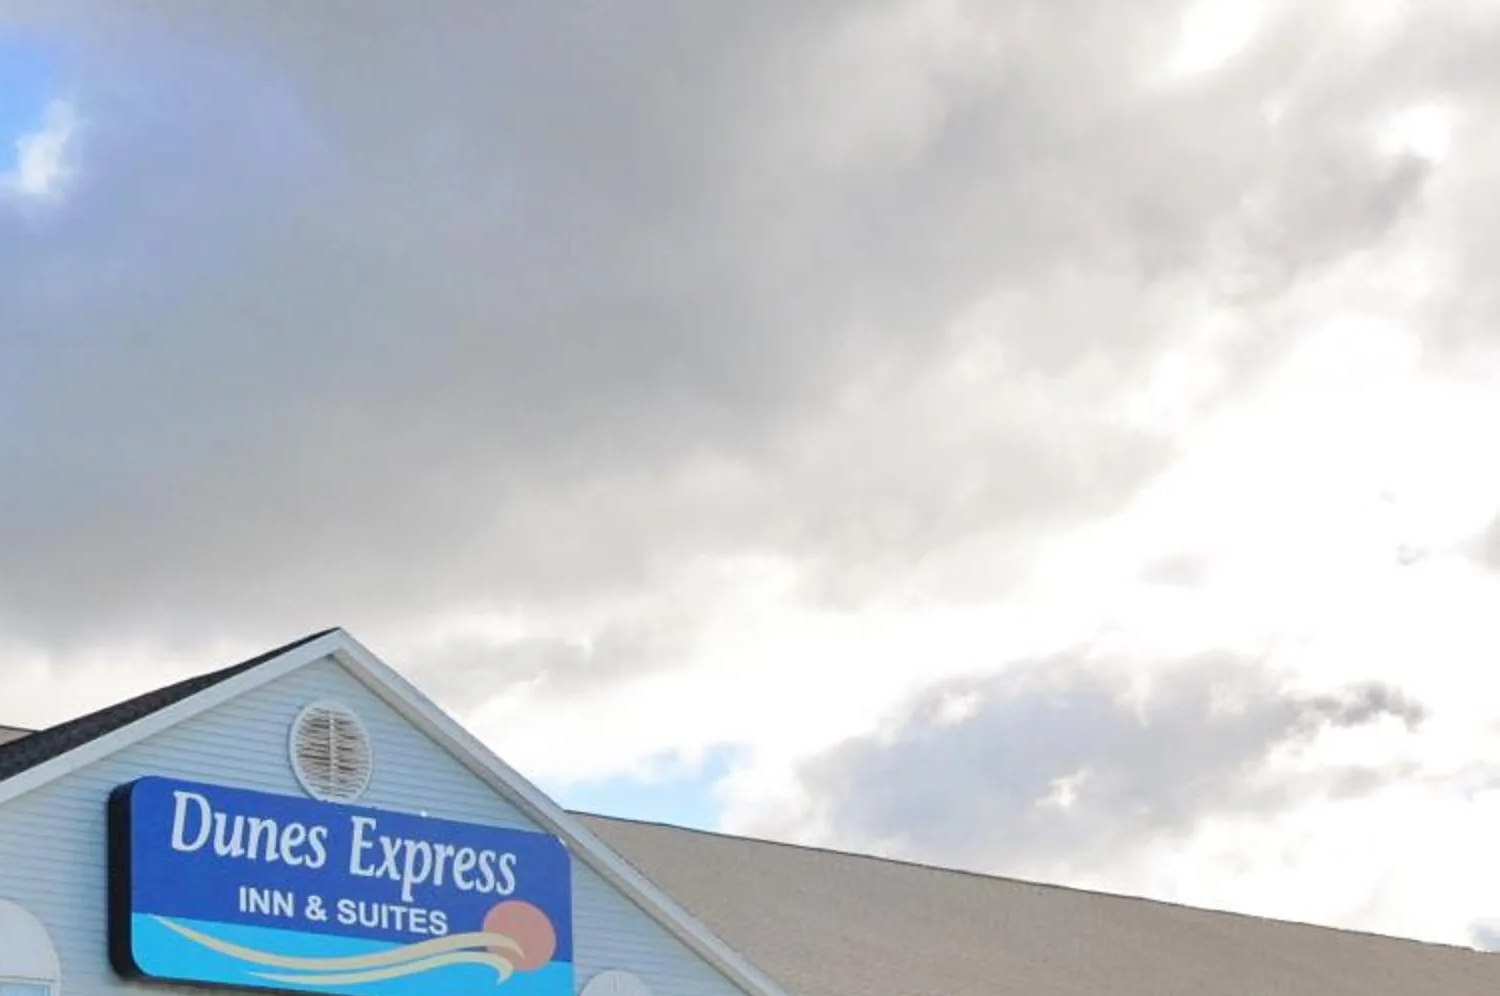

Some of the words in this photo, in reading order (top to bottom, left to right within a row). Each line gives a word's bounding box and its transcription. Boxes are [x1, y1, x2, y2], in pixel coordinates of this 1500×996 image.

[170, 789, 328, 869] Dunes
[349, 816, 518, 902] Express
[238, 886, 294, 918] INN
[305, 896, 328, 922] &
[337, 898, 449, 936] SUITES
